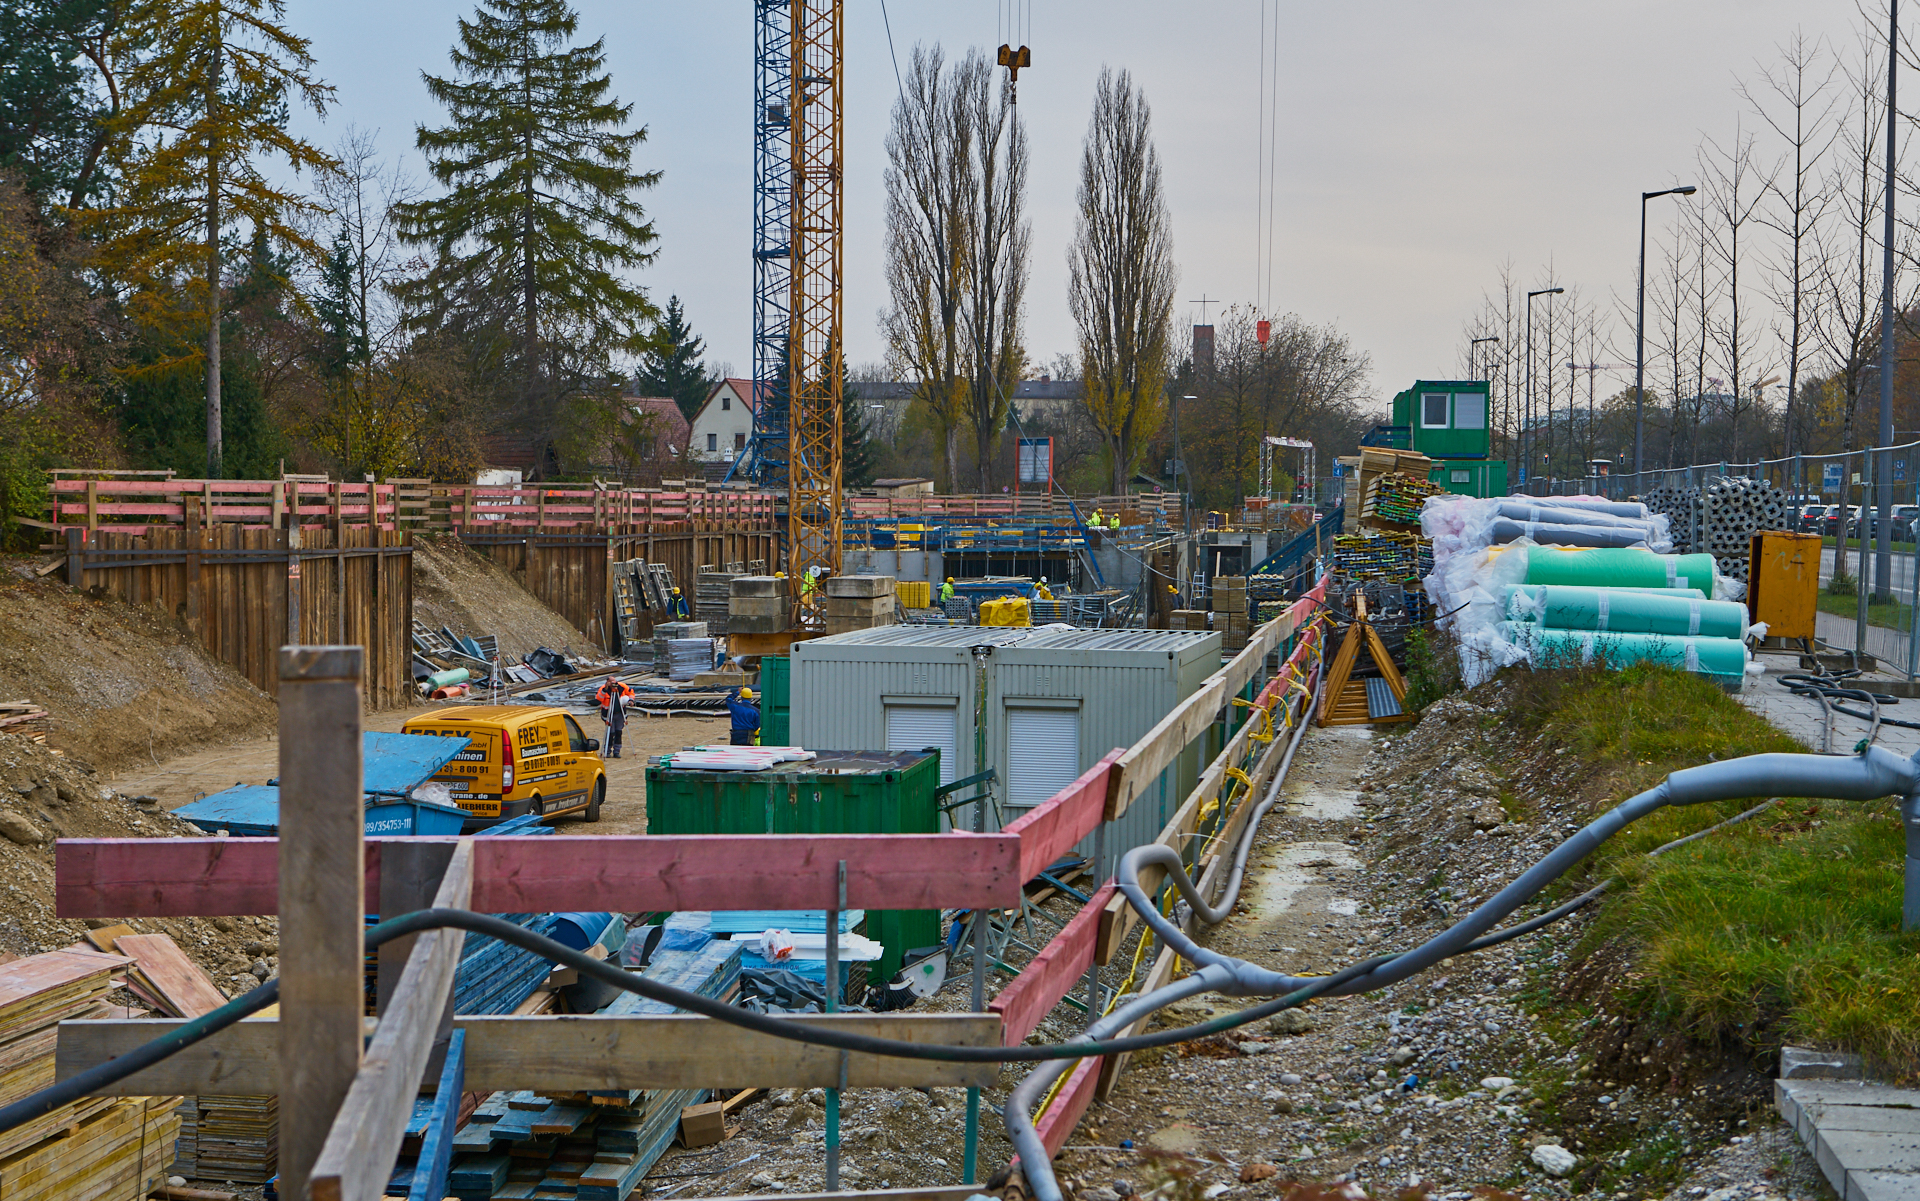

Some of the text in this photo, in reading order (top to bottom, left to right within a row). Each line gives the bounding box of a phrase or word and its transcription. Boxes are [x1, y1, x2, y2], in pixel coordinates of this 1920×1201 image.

[518, 726, 539, 745] FREY
[813, 791, 820, 802] 3
[458, 803, 498, 811] LIEBHERR
